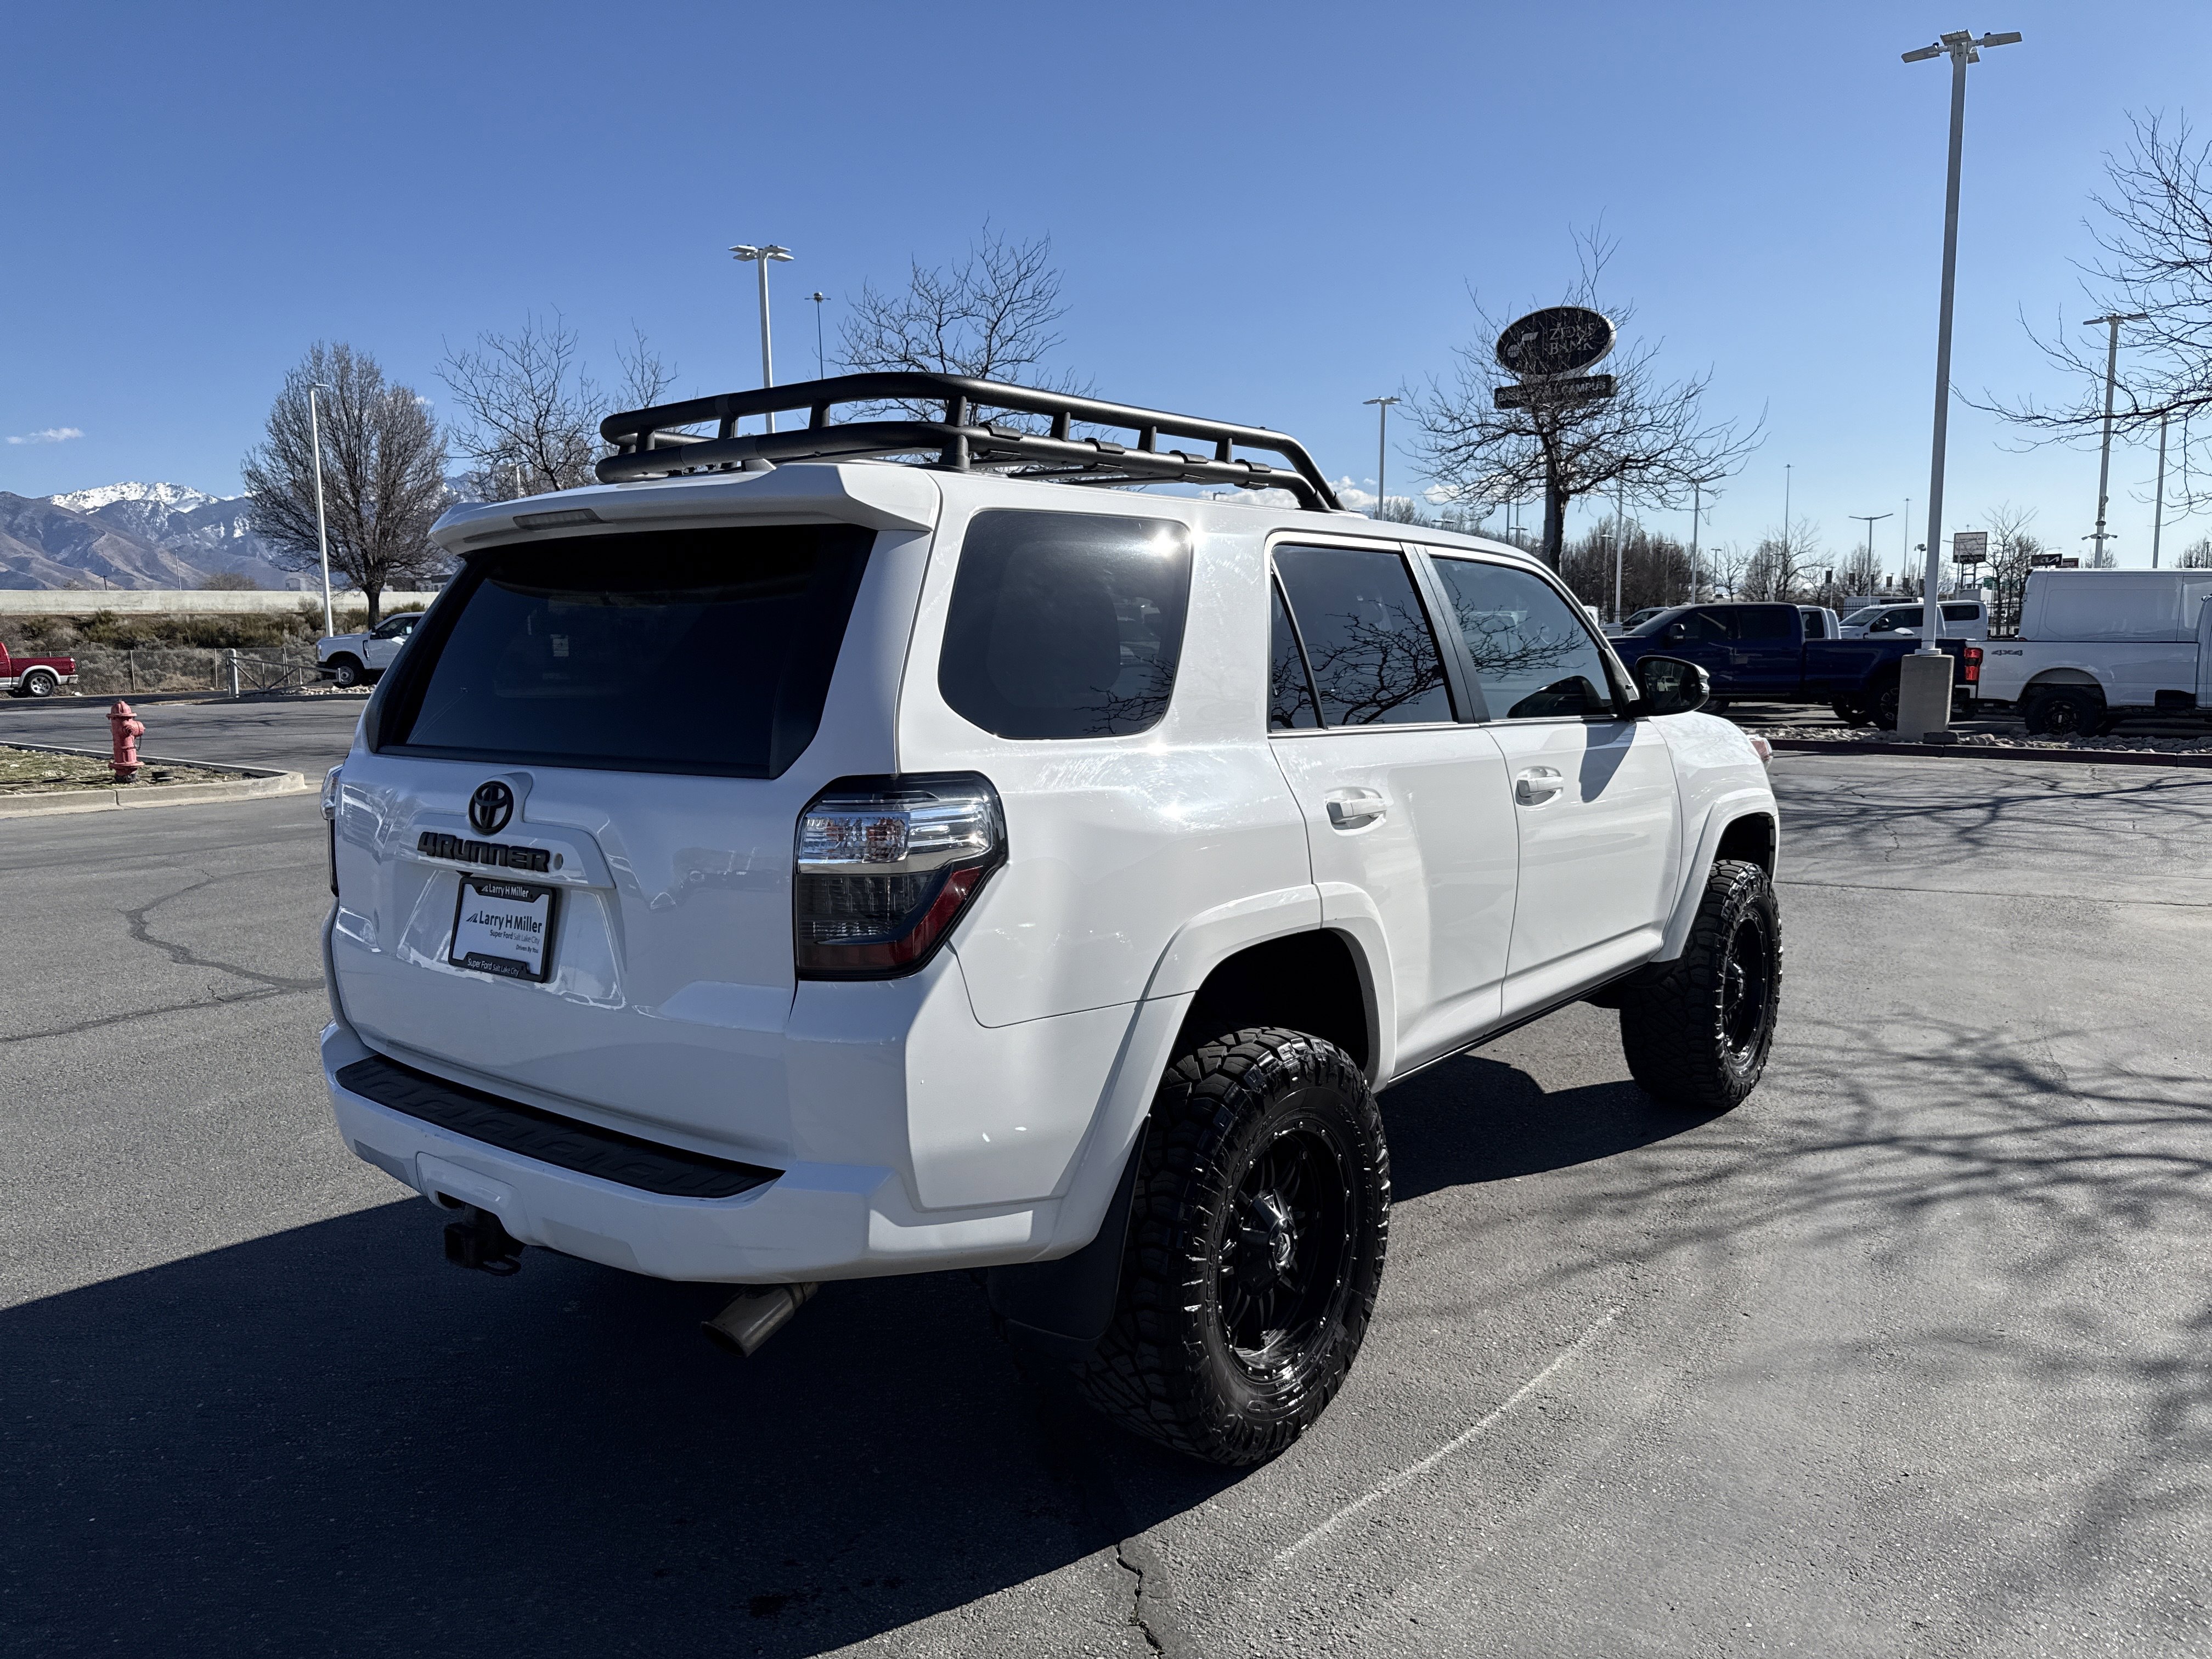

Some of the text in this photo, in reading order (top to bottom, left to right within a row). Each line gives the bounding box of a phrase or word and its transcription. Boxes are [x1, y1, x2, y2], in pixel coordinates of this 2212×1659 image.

[1549, 323, 1595, 341] ZIONS
[489, 883, 529, 898] Larry H Miller
[479, 911, 542, 933] Larry H Miller
[490, 929, 503, 938] Super
[521, 934, 531, 943] Lake
[532, 936, 540, 946] City
[467, 958, 481, 968] Super
[481, 961, 493, 970] Ford
[501, 966, 510, 974] Lake
[511, 967, 519, 977] City
